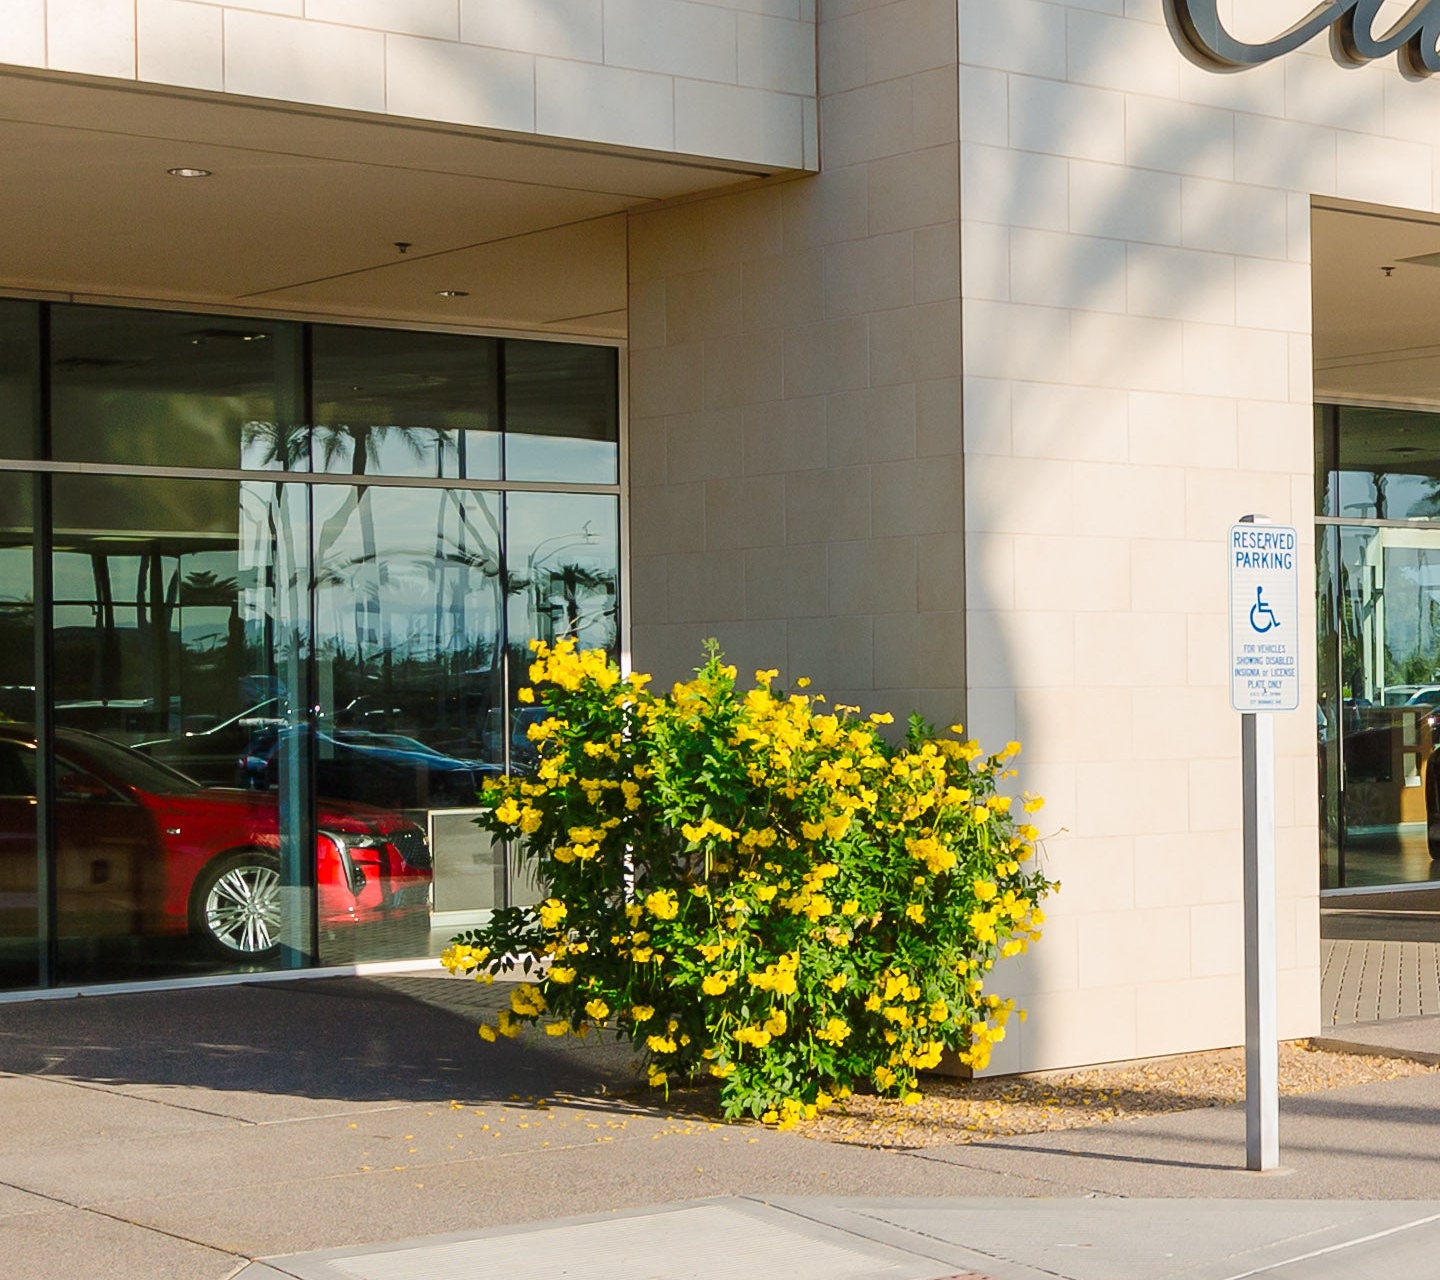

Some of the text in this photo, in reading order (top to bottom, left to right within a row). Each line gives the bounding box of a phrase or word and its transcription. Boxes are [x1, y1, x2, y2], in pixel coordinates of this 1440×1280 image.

[1233, 531, 1294, 550] RESERVED
[1236, 551, 1292, 570] PARKING
[1244, 644, 1255, 653] FOR
[1266, 656, 1293, 665] DISABLED
